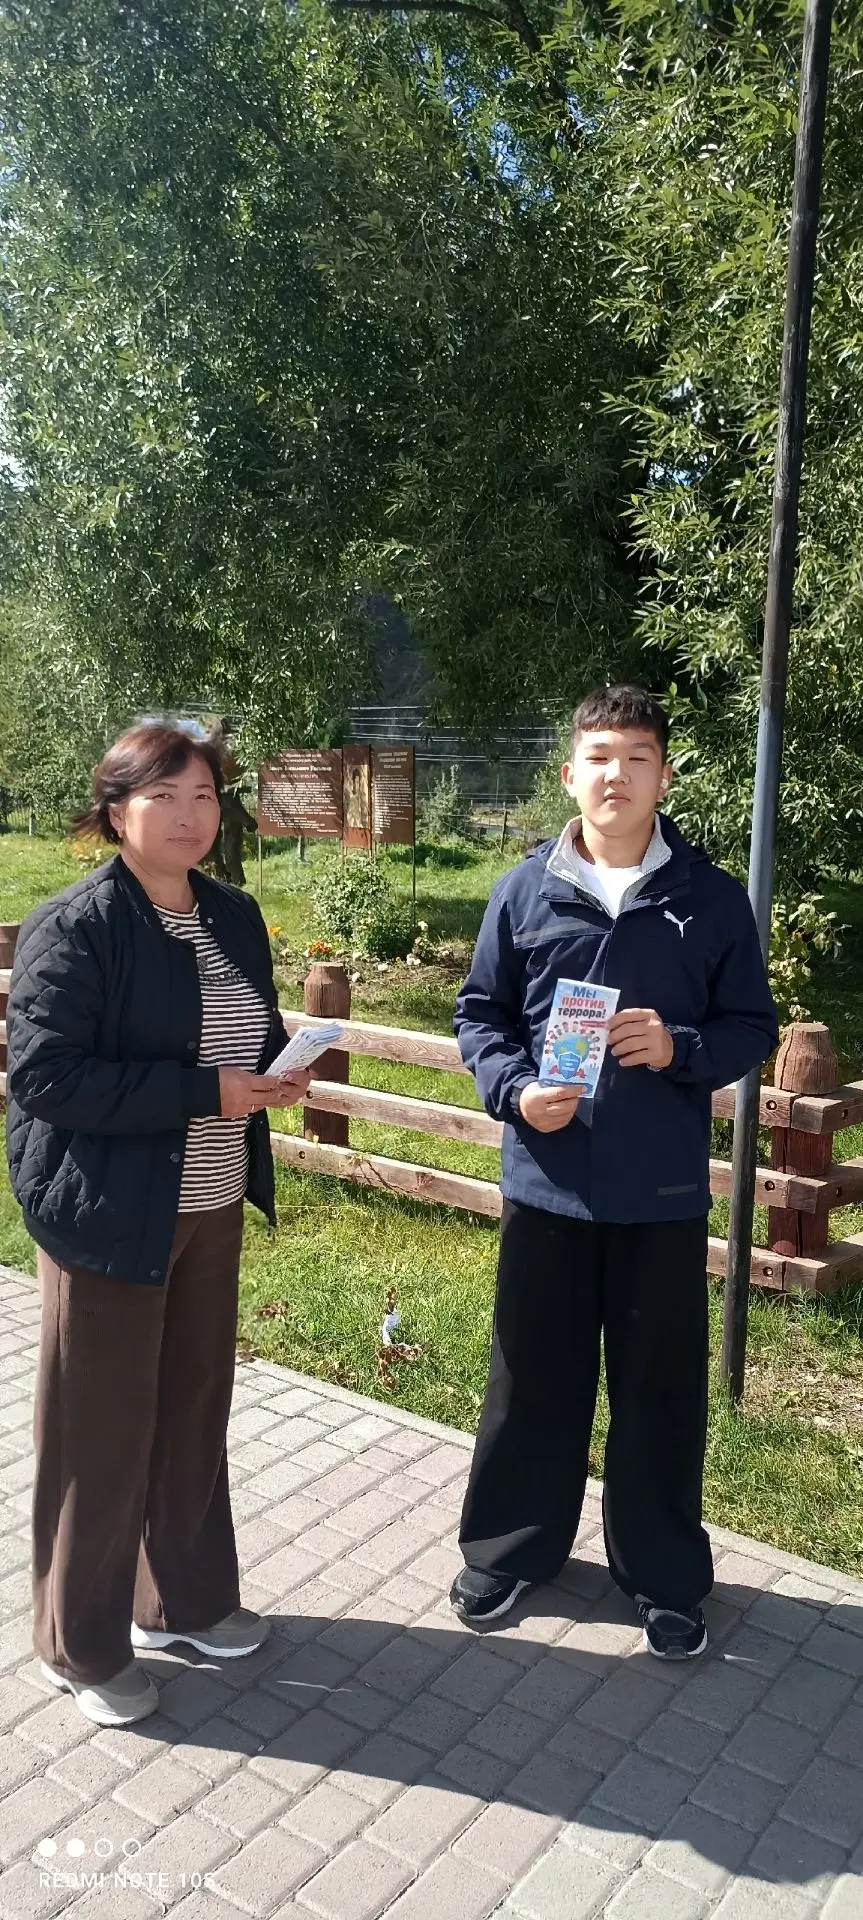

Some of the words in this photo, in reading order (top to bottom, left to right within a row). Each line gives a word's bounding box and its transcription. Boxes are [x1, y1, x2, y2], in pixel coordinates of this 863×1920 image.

[573, 986, 597, 998] Мы
[561, 996, 605, 1009] против
[557, 1007, 607, 1019] террора!
